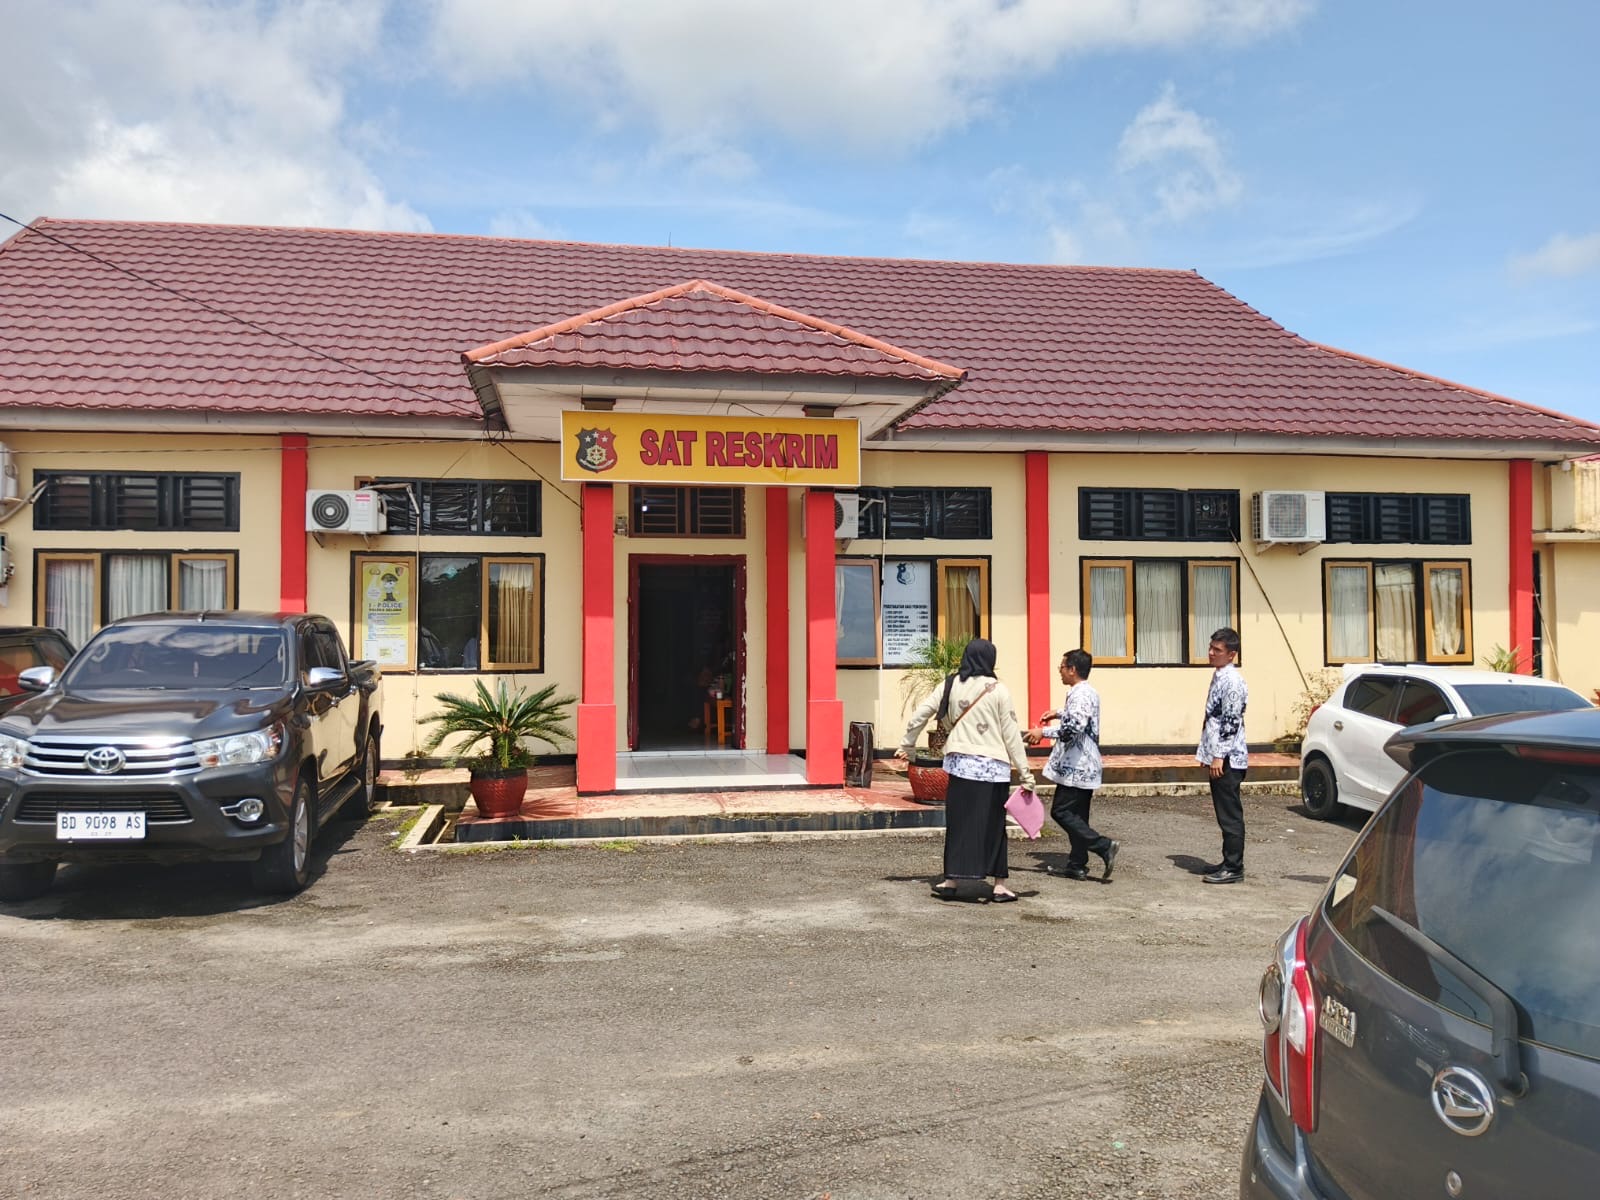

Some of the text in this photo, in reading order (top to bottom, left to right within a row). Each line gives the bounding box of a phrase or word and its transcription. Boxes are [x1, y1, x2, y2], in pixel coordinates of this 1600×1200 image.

[639, 428, 839, 469] SAT RESKRIM
[61, 816, 142, 830] BD 9098 AS
